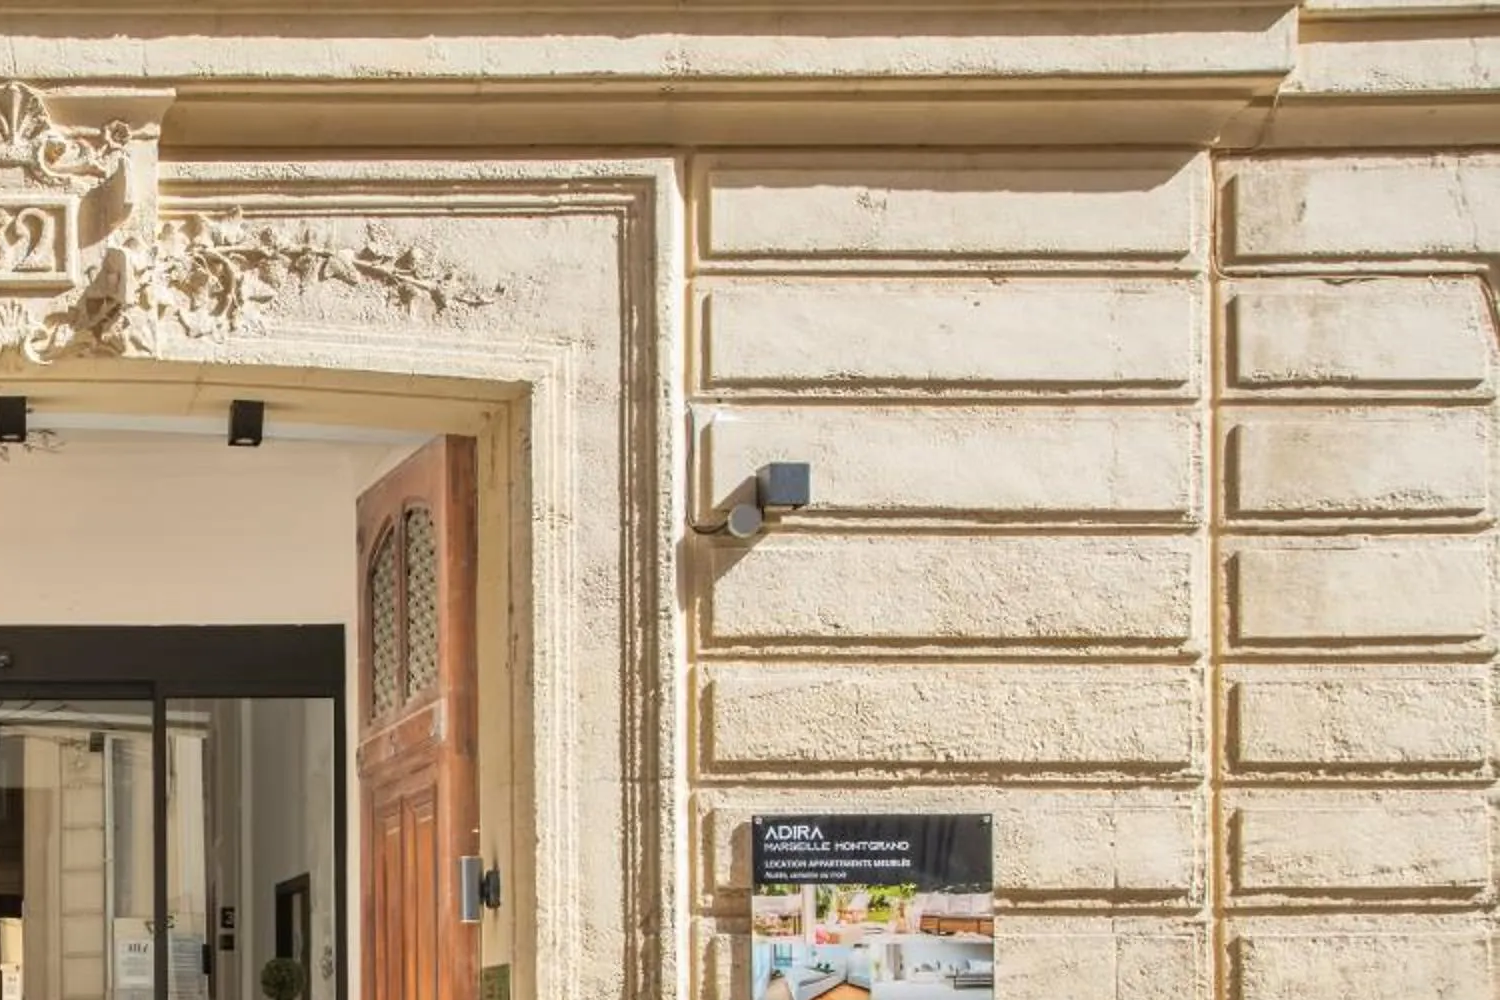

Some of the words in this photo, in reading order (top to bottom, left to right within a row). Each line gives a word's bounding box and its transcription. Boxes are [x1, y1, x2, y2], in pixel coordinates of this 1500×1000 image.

[764, 825, 824, 840] ADIRA
[764, 841, 831, 851] MARSEILLE
[835, 841, 910, 851] MONTGRAND
[764, 859, 806, 868] LOCATION
[808, 859, 872, 867] APPARTEMENTS
